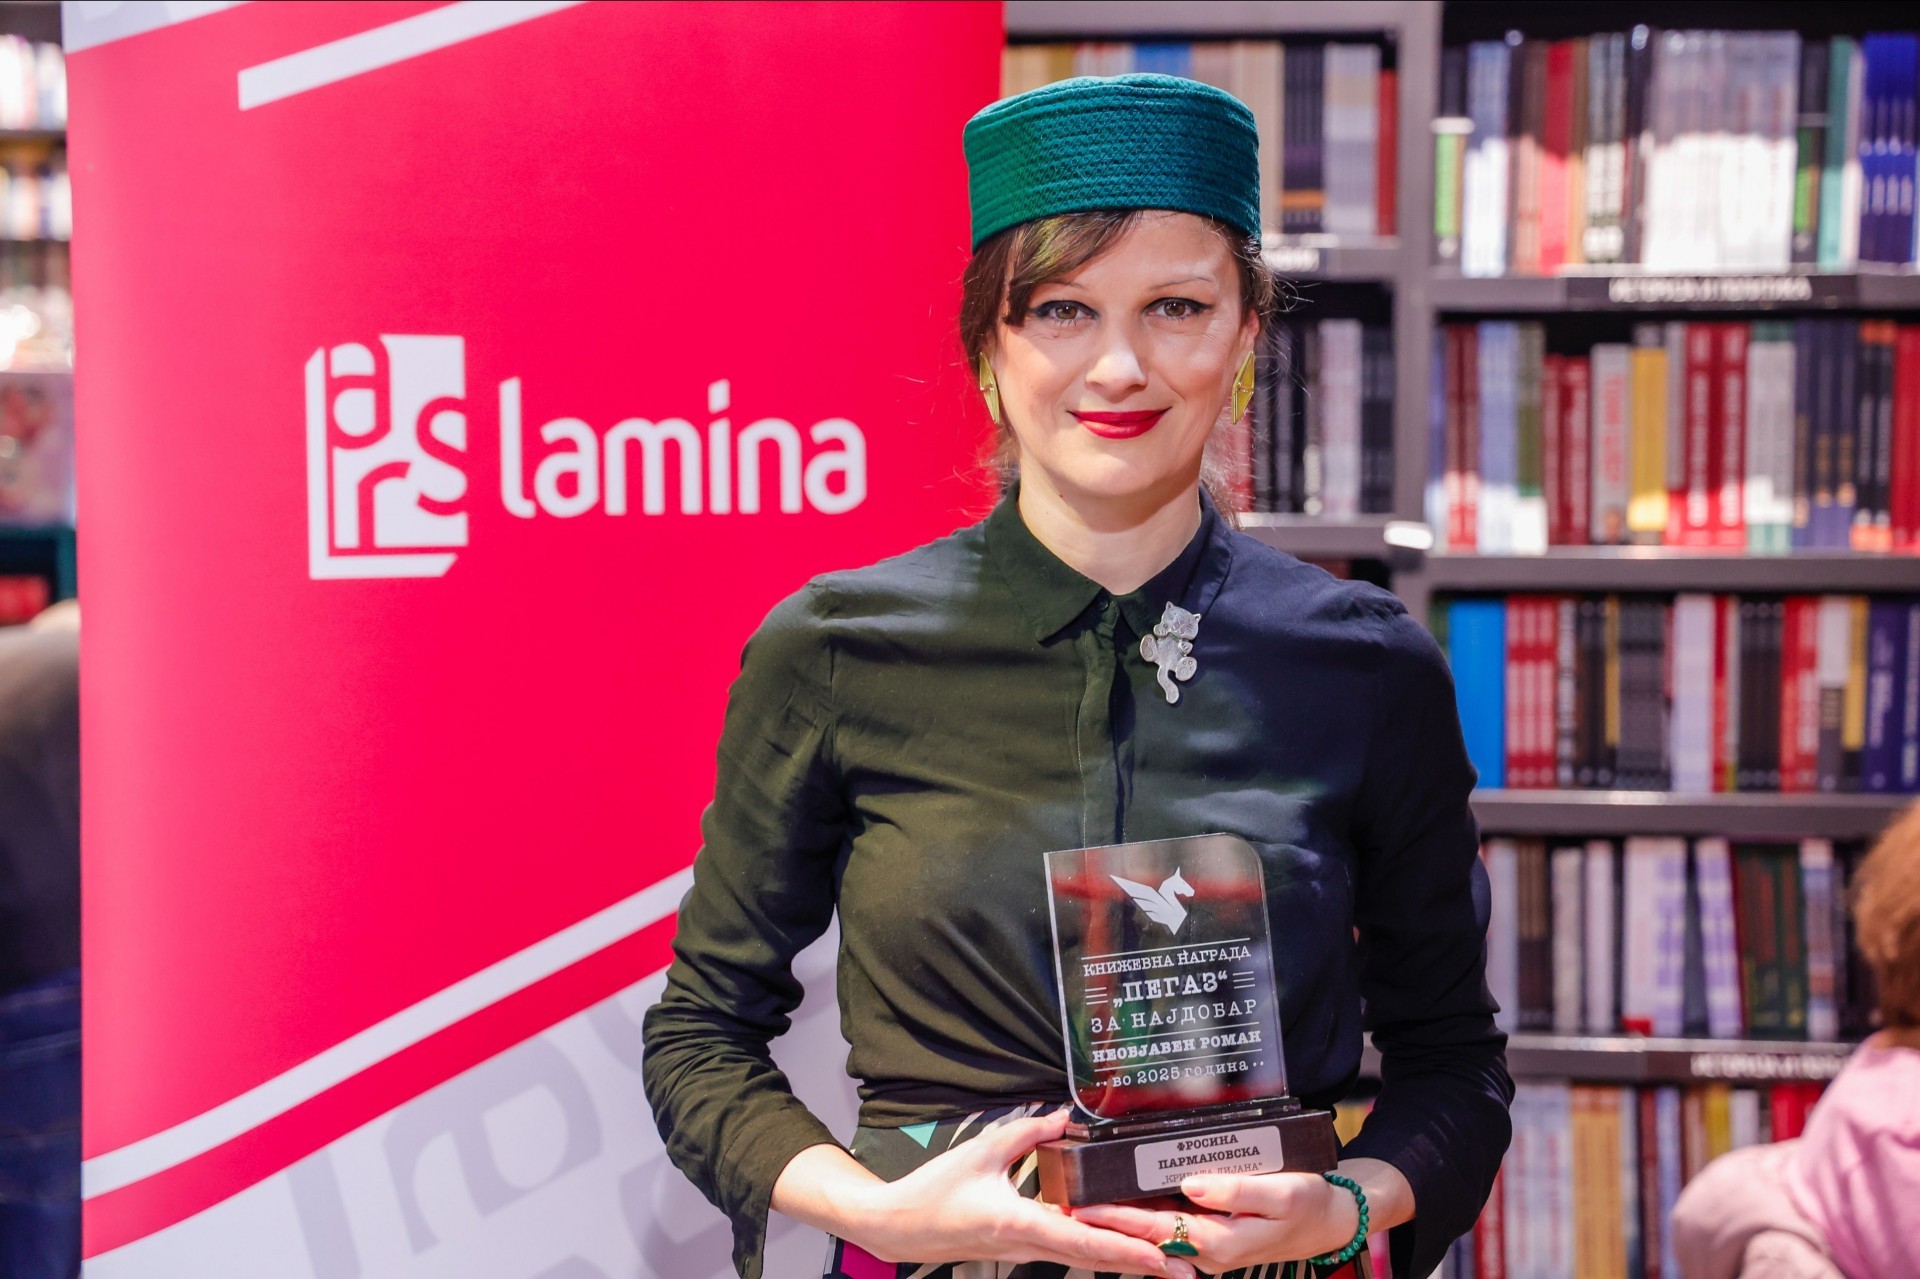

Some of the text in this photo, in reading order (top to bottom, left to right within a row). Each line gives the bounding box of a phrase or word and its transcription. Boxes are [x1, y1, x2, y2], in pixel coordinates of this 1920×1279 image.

[498, 376, 867, 519] lamina
[1083, 946, 1252, 977] КНИЖЕВНА НАГРАДА
[1091, 999, 1257, 1033] ЗА НАЈДОБАР
[1092, 1030, 1262, 1063] НЕОБЈАВЕН РОМАН
[1112, 1060, 1249, 1087] во 2025 година
[1158, 1146, 1260, 1170] ПАРМАКОВСКА
[1176, 1134, 1238, 1151] ФРОСИНА
